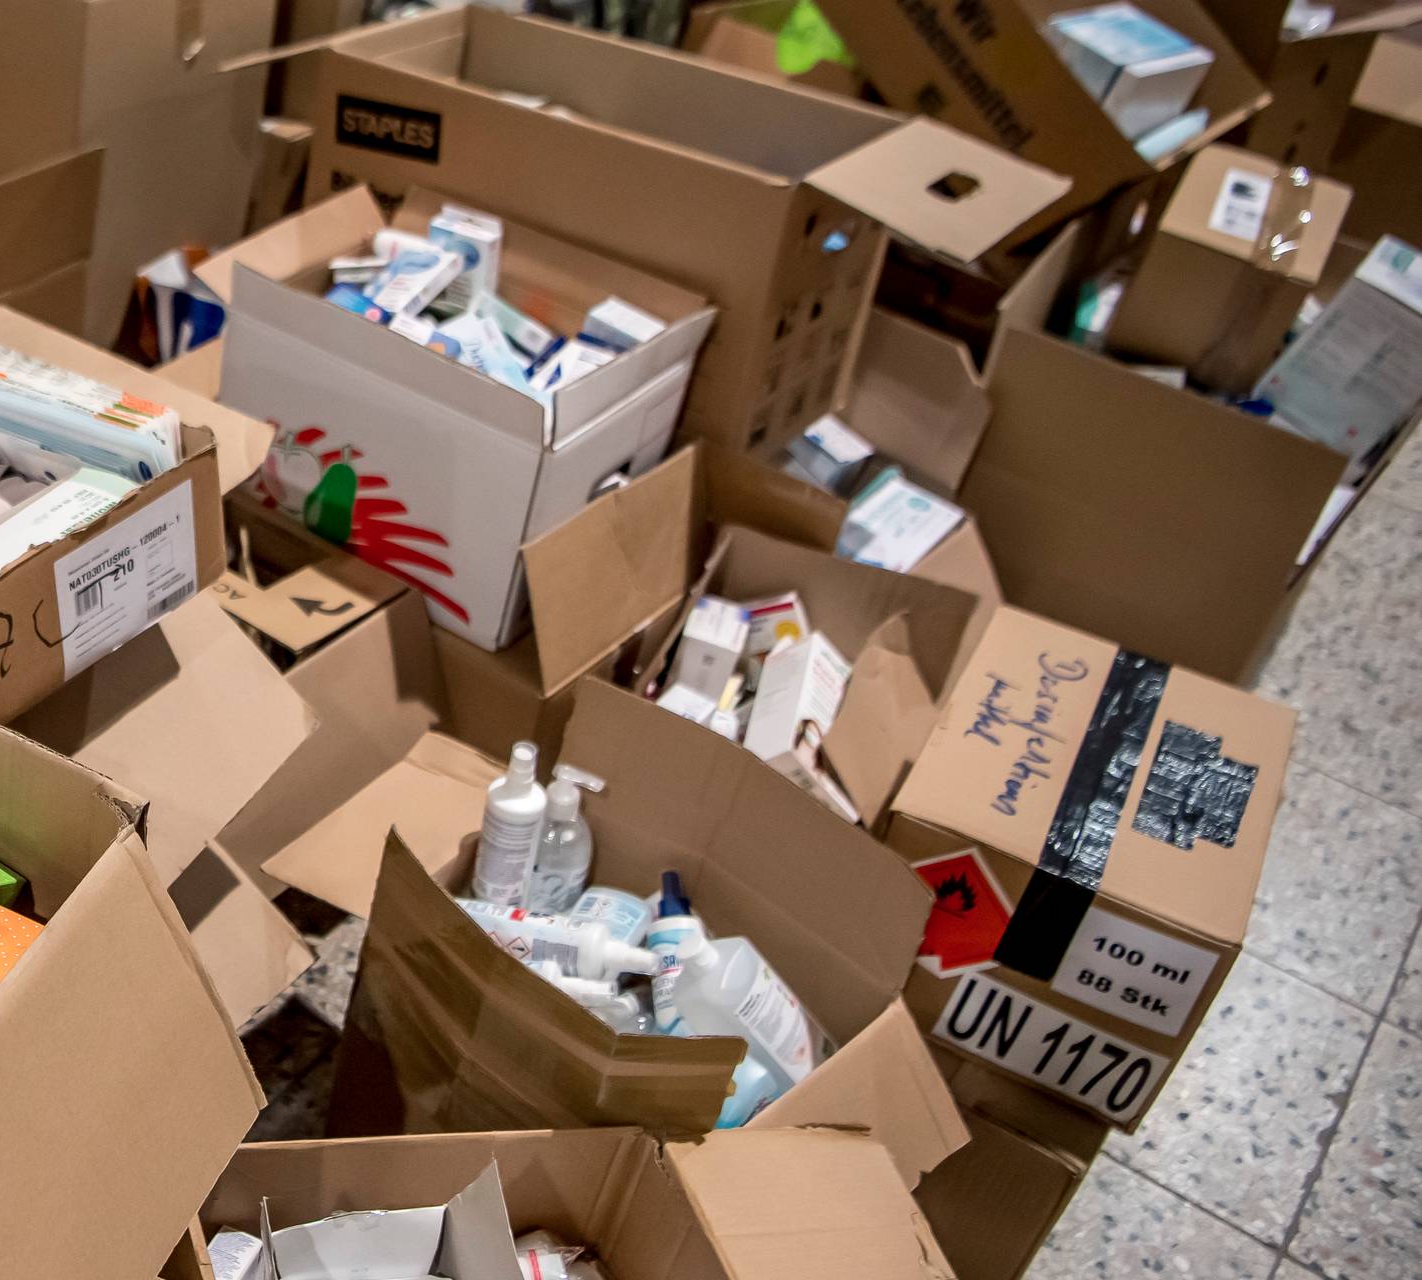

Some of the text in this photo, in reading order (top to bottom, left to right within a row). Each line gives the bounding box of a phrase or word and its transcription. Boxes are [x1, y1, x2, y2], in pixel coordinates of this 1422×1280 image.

[343, 109, 435, 149] STAPLES
[1093, 936, 1191, 986] 100 ml
[1076, 969, 1170, 1017] 88 Stk
[947, 978, 1152, 1112] UN 1170
